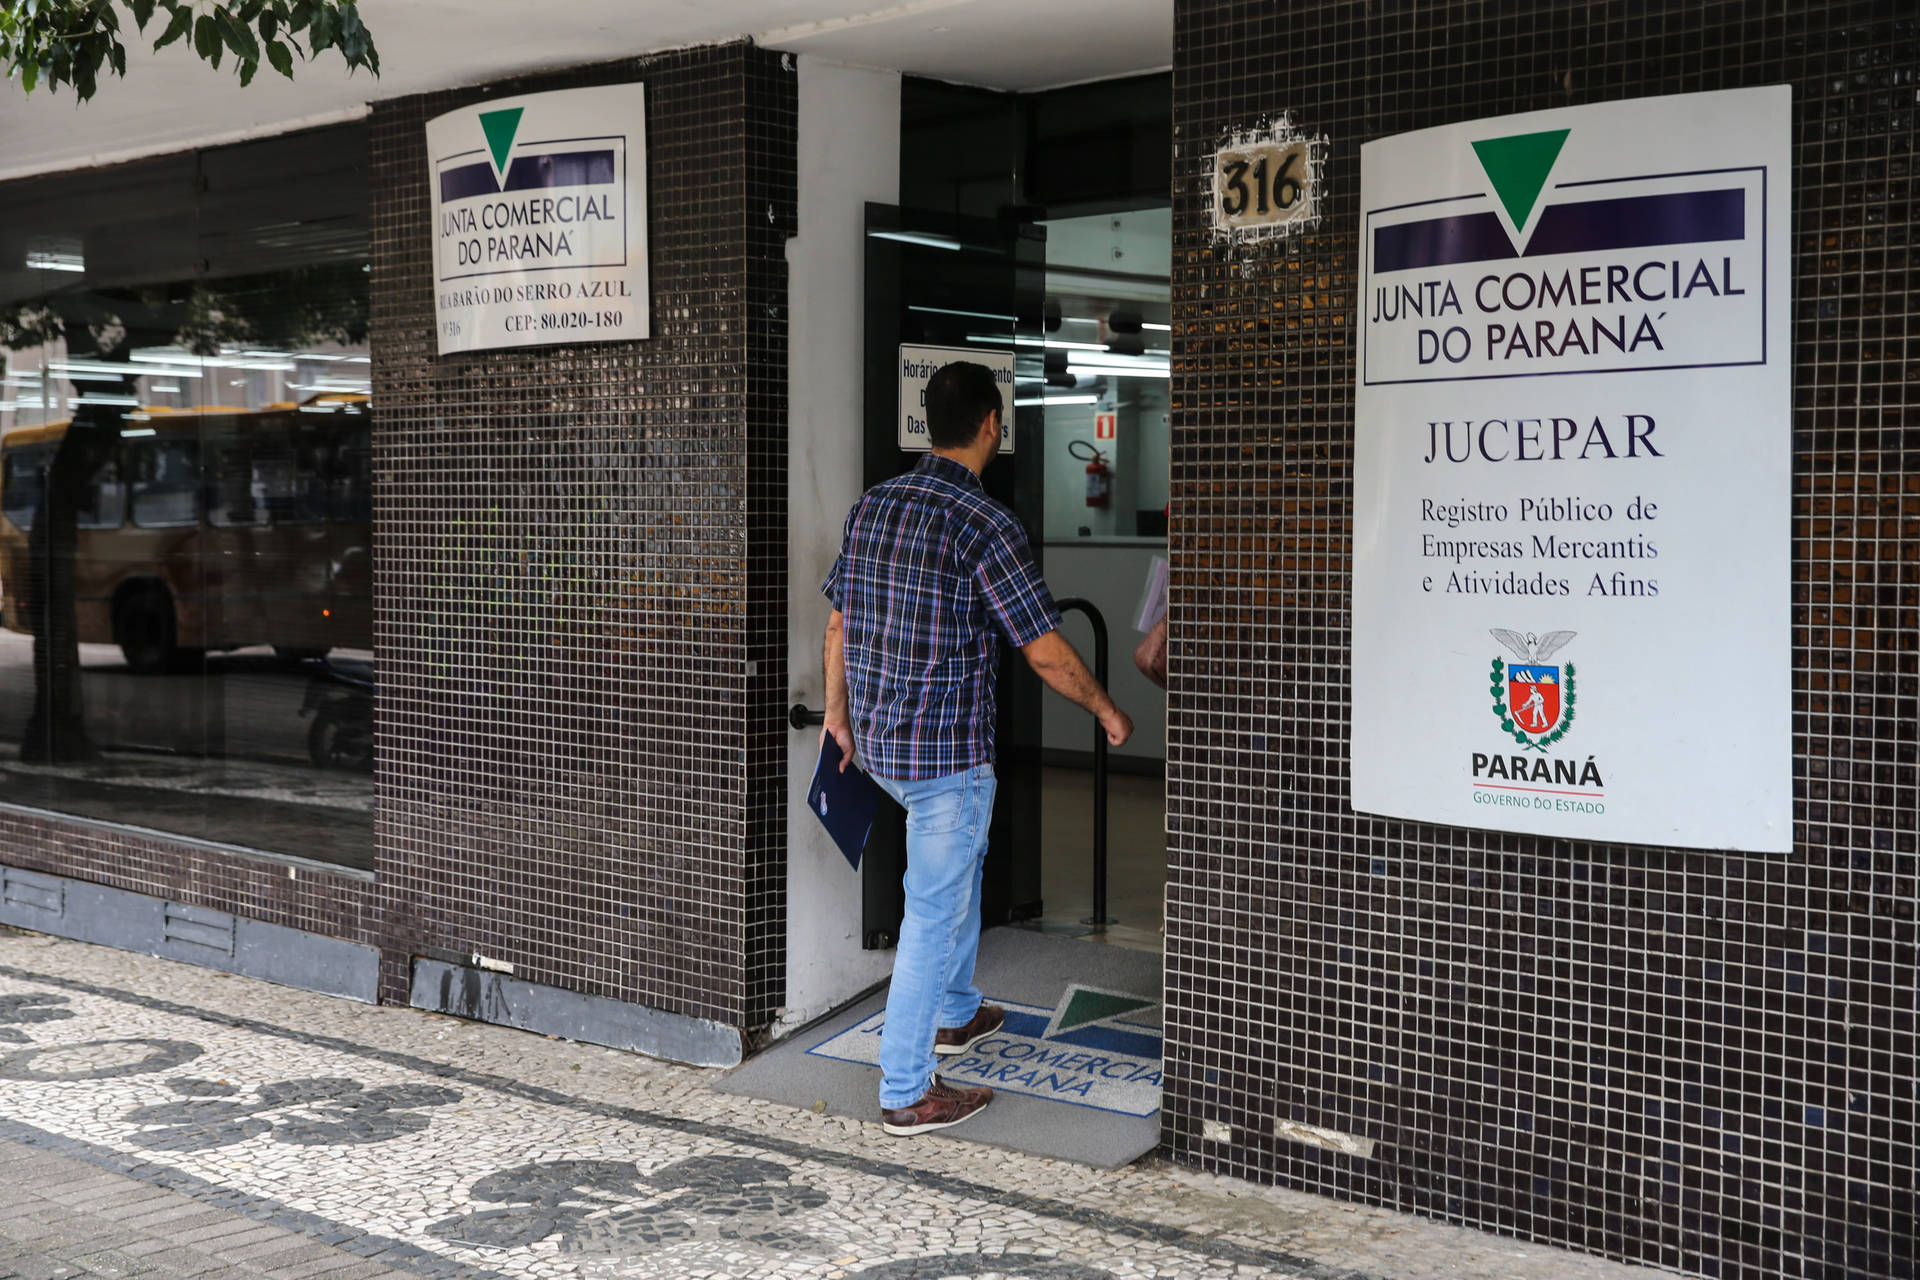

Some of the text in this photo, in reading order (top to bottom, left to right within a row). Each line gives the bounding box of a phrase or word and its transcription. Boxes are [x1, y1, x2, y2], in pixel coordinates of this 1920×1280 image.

[1223, 153, 1301, 215] 316
[442, 194, 615, 238] JUNTA COMERCIAL
[458, 229, 574, 266] DO PARANÁ
[453, 285, 490, 307] BARÃO
[494, 286, 512, 303] DO
[517, 283, 571, 302] SERRO
[577, 280, 632, 299] AZUL
[1373, 256, 1745, 323] JUNTA COMERCIAL
[1418, 311, 1667, 365] DO PARANÁ
[907, 415, 926, 434] Das
[1424, 414, 1665, 464] JUCEPAR
[1421, 495, 1658, 528] Registro Público de
[1422, 533, 1658, 564] Empresas Mercantis
[1422, 570, 1659, 597] e Atividades Afins
[1472, 752, 1604, 788] PARANÁ
[1473, 791, 1605, 815] GOVERNO DO ESTADO
[974, 1039, 1164, 1087] COMERCIA
